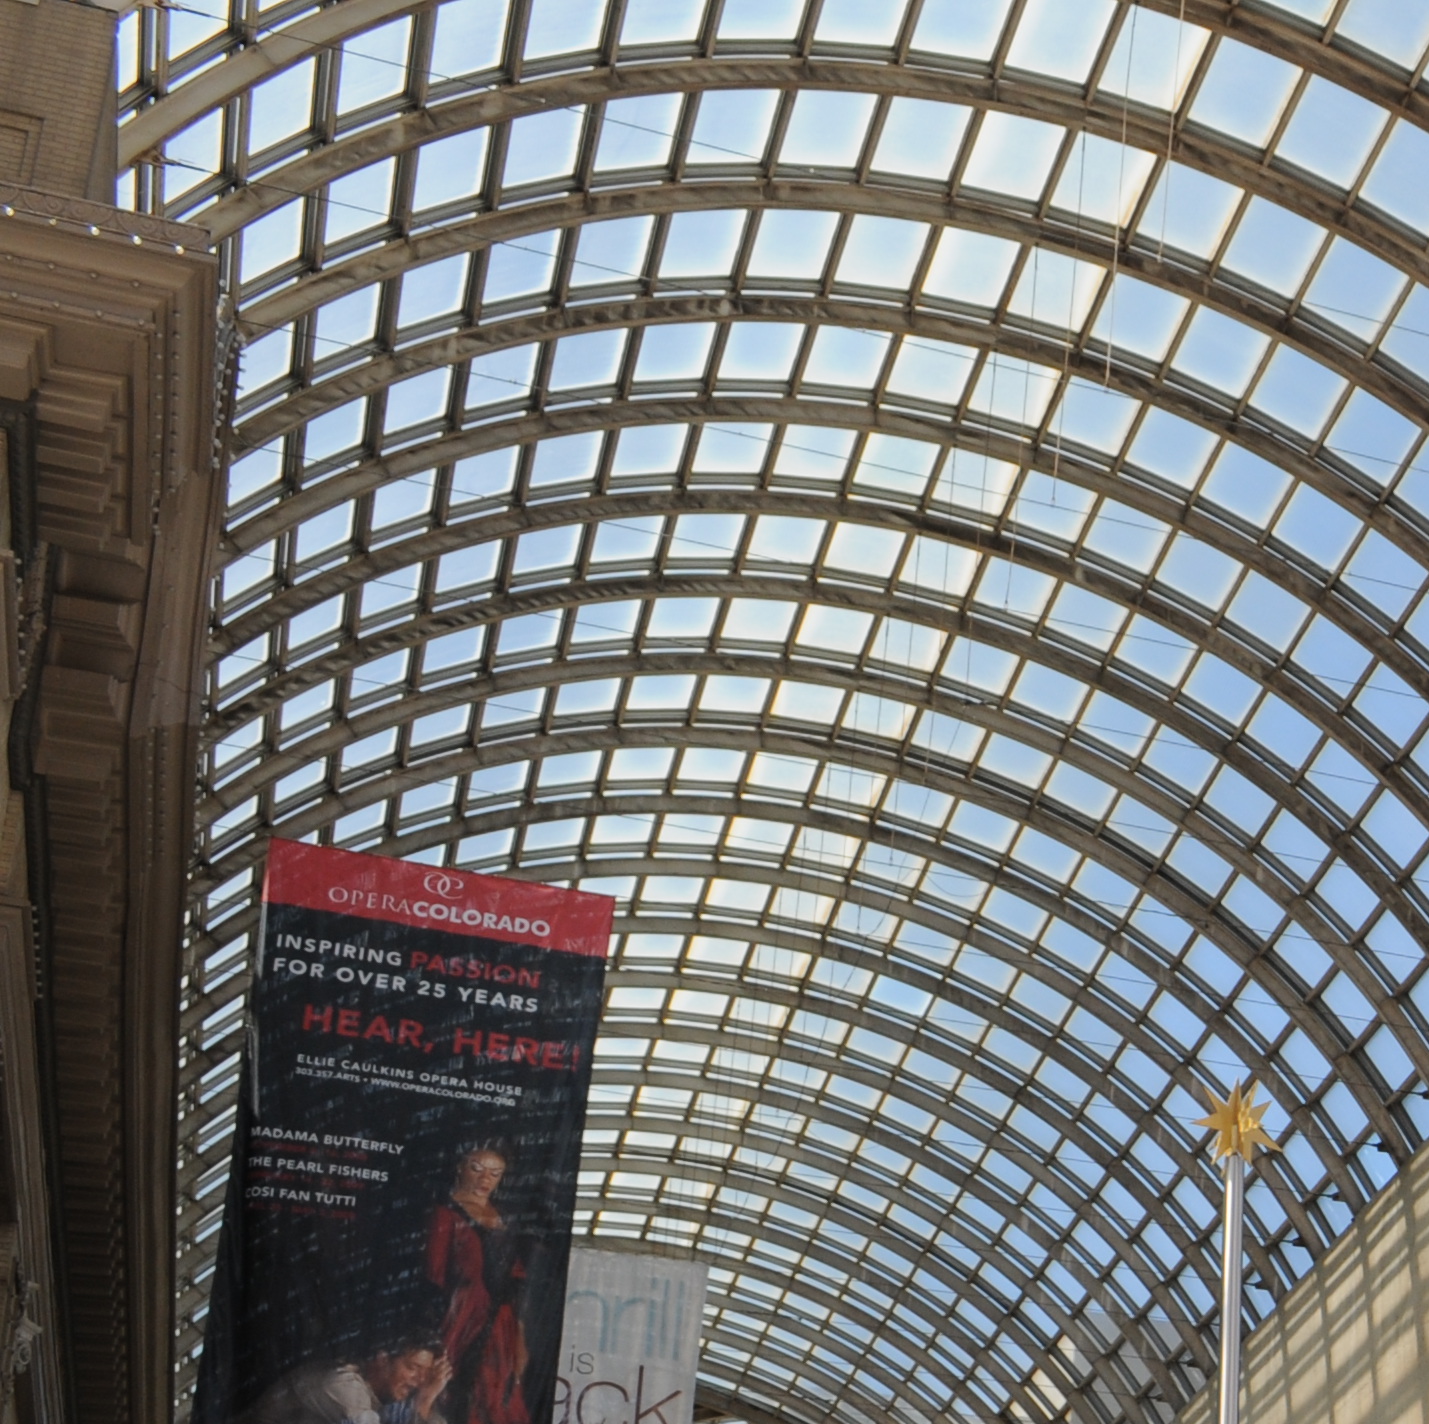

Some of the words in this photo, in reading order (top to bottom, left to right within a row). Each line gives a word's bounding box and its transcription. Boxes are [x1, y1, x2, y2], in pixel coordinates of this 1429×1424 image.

[328, 886, 551, 937] OPERACOLORADO
[276, 933, 402, 967] INSPIRING
[409, 950, 540, 989] PASSION
[273, 957, 324, 978] FOR
[336, 965, 406, 992] OVER
[416, 980, 446, 998] 25
[458, 986, 539, 1012] YEARS
[302, 1003, 434, 1053] HEAR,
[453, 1027, 581, 1072] HERE!
[297, 1053, 336, 1067] ELLIE
[341, 1059, 414, 1080] CAULKINS
[419, 1072, 468, 1089] OPERA
[473, 1079, 523, 1097] HOUSE
[251, 1126, 318, 1144] MADAMA
[323, 1134, 404, 1155] BUTTERFLY
[249, 1157, 272, 1168] THE
[277, 1158, 324, 1174] PEARL
[328, 1164, 389, 1182] FISHERS
[279, 1188, 310, 1201] FAN
[315, 1191, 356, 1207] TUTTI
[570, 1344, 594, 1375] is
